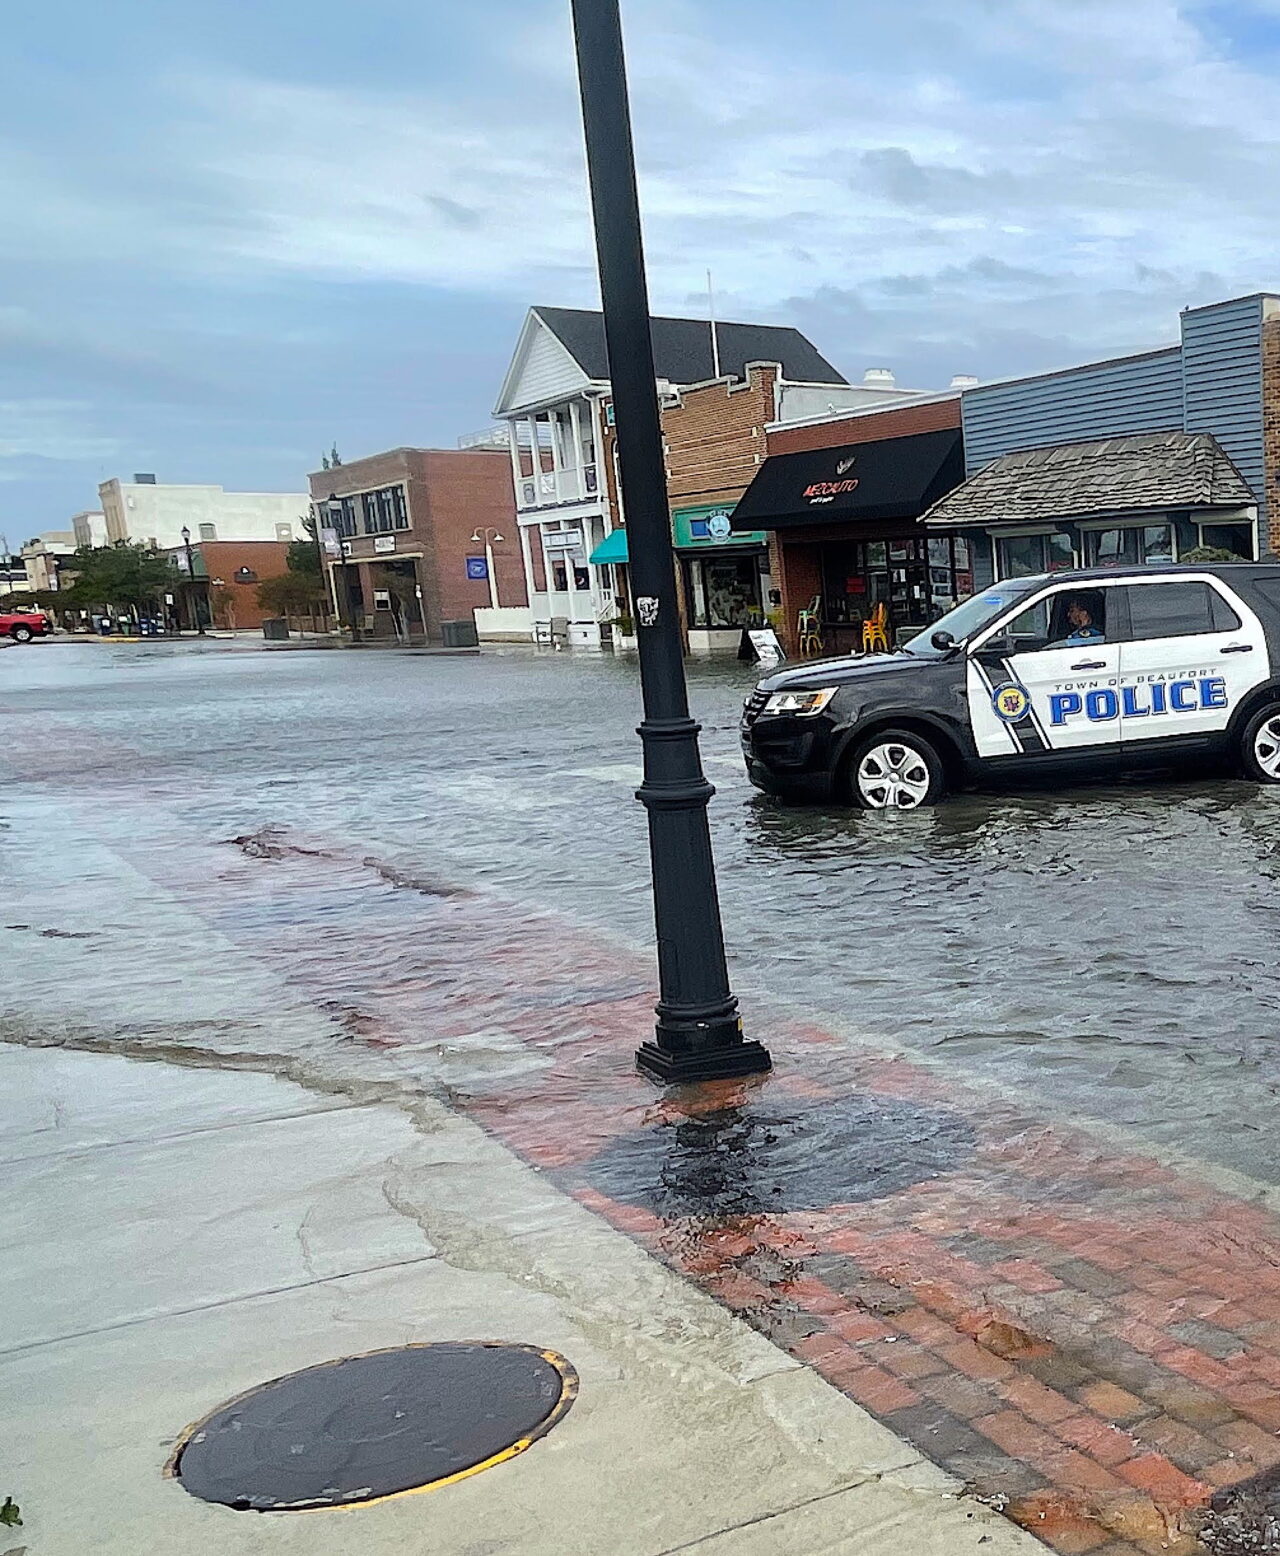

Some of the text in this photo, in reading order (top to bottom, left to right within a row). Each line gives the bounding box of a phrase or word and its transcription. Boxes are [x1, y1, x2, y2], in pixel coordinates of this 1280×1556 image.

[1054, 668, 1217, 692] TOWN OF BEAUFORT
[1047, 675, 1229, 727] POLICE
